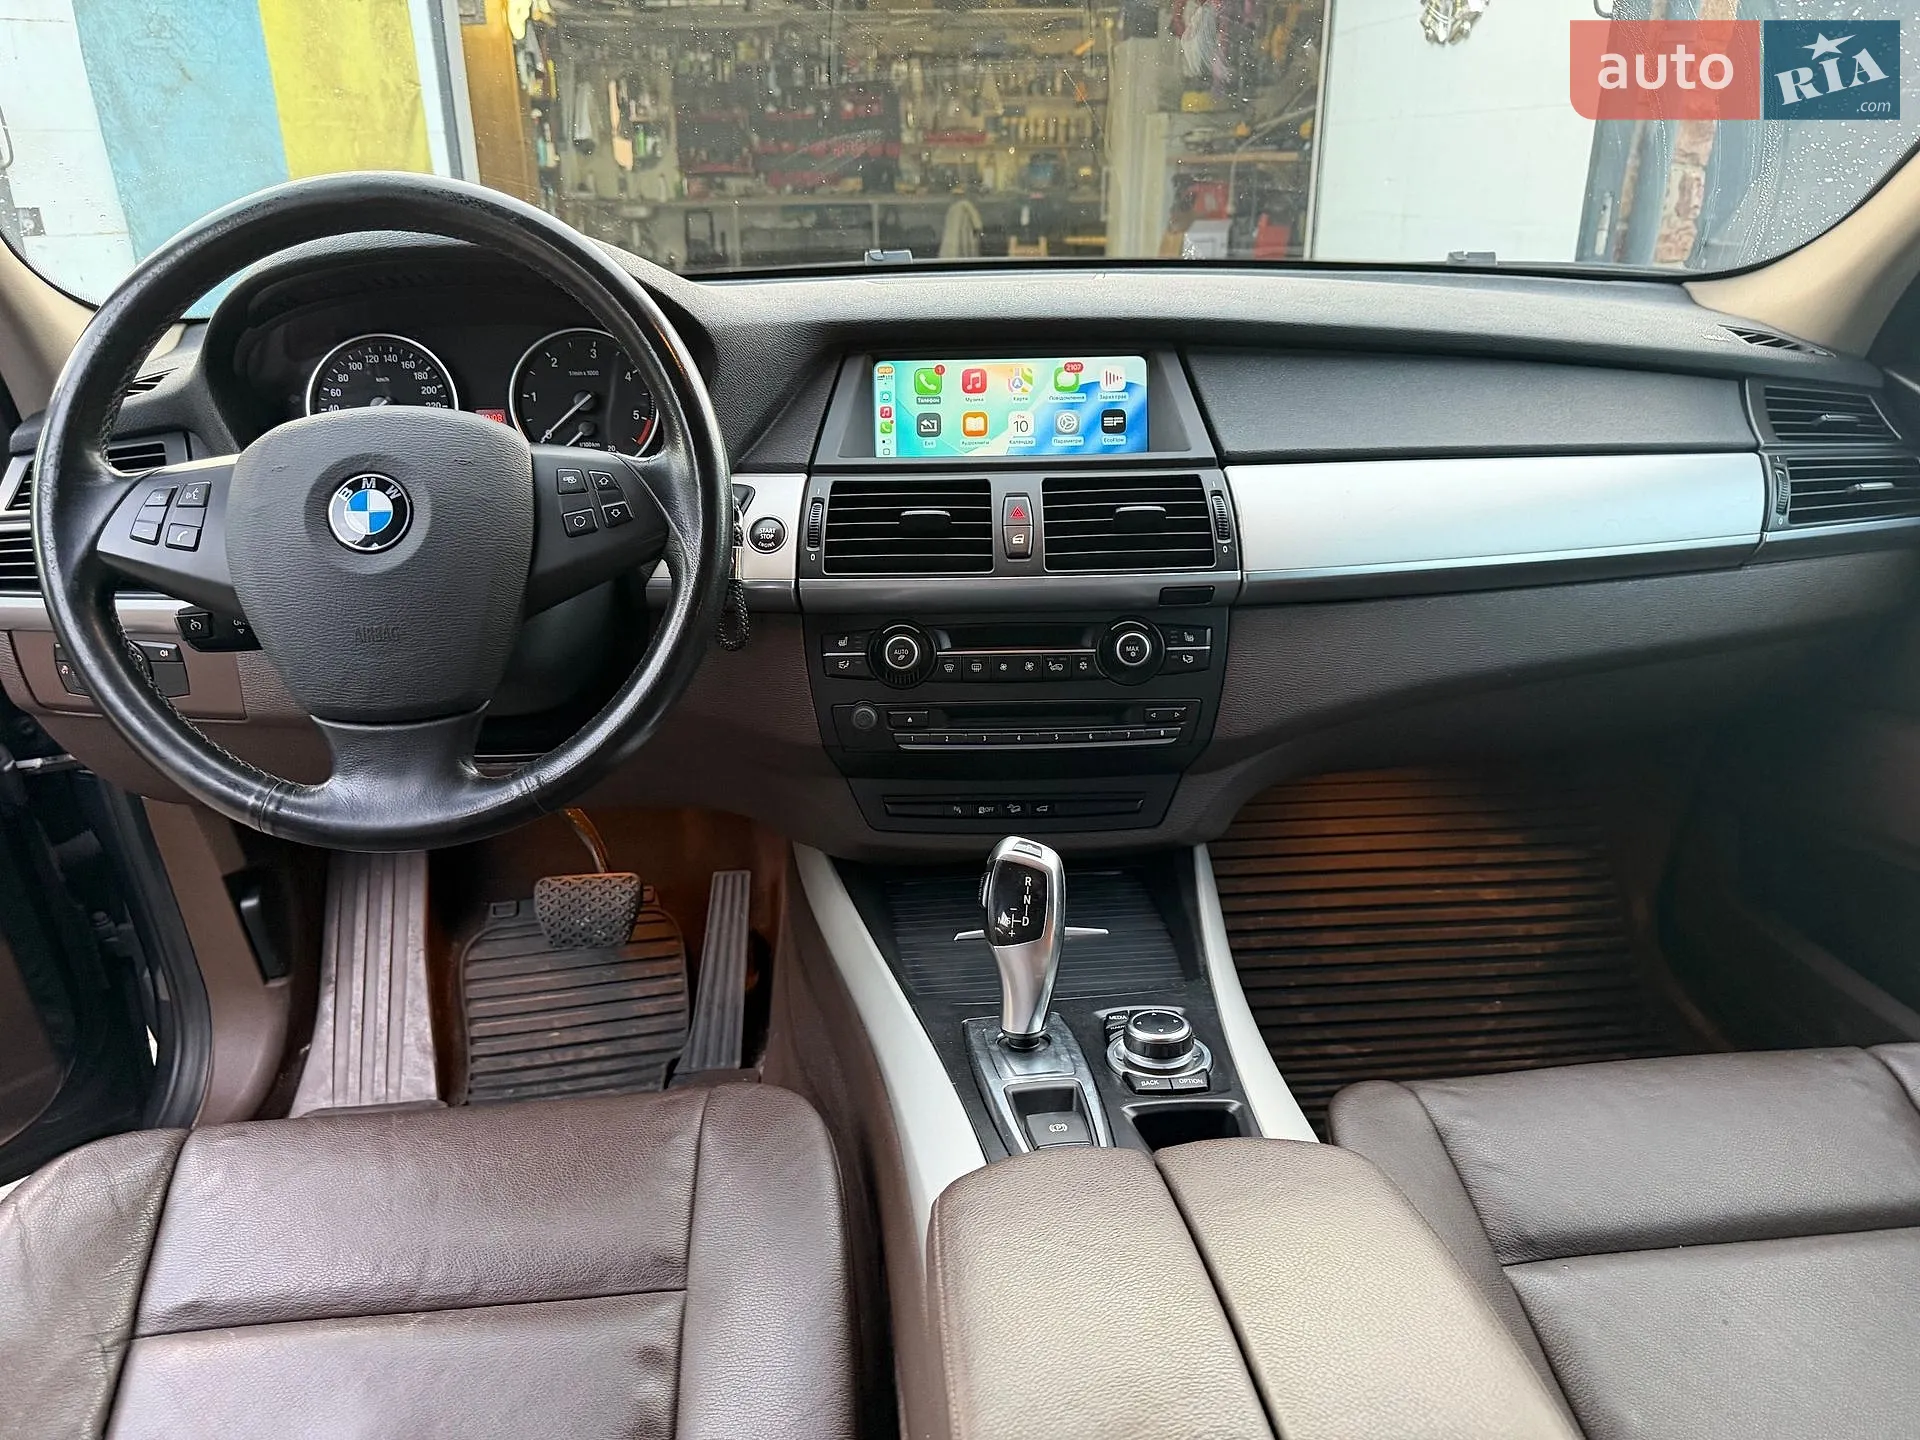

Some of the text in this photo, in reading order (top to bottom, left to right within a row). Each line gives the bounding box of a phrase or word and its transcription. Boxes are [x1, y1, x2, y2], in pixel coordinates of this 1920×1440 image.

[590, 349, 597, 358] 3
[365, 355, 379, 363] 120
[384, 354, 398, 363] 140
[551, 357, 558, 368] 2
[349, 361, 363, 370] 100
[401, 361, 415, 369] 160
[337, 373, 349, 382] 80
[414, 372, 428, 380] 180
[624, 372, 632, 382] 4
[330, 388, 342, 397] 60
[421, 386, 437, 395] 200
[633, 411, 639, 420] 5
[1013, 420, 1029, 433] 10
[337, 477, 402, 502] BMW
[1024, 876, 1032, 887] R
[1023, 895, 1031, 905] N
[1021, 916, 1030, 927] D
